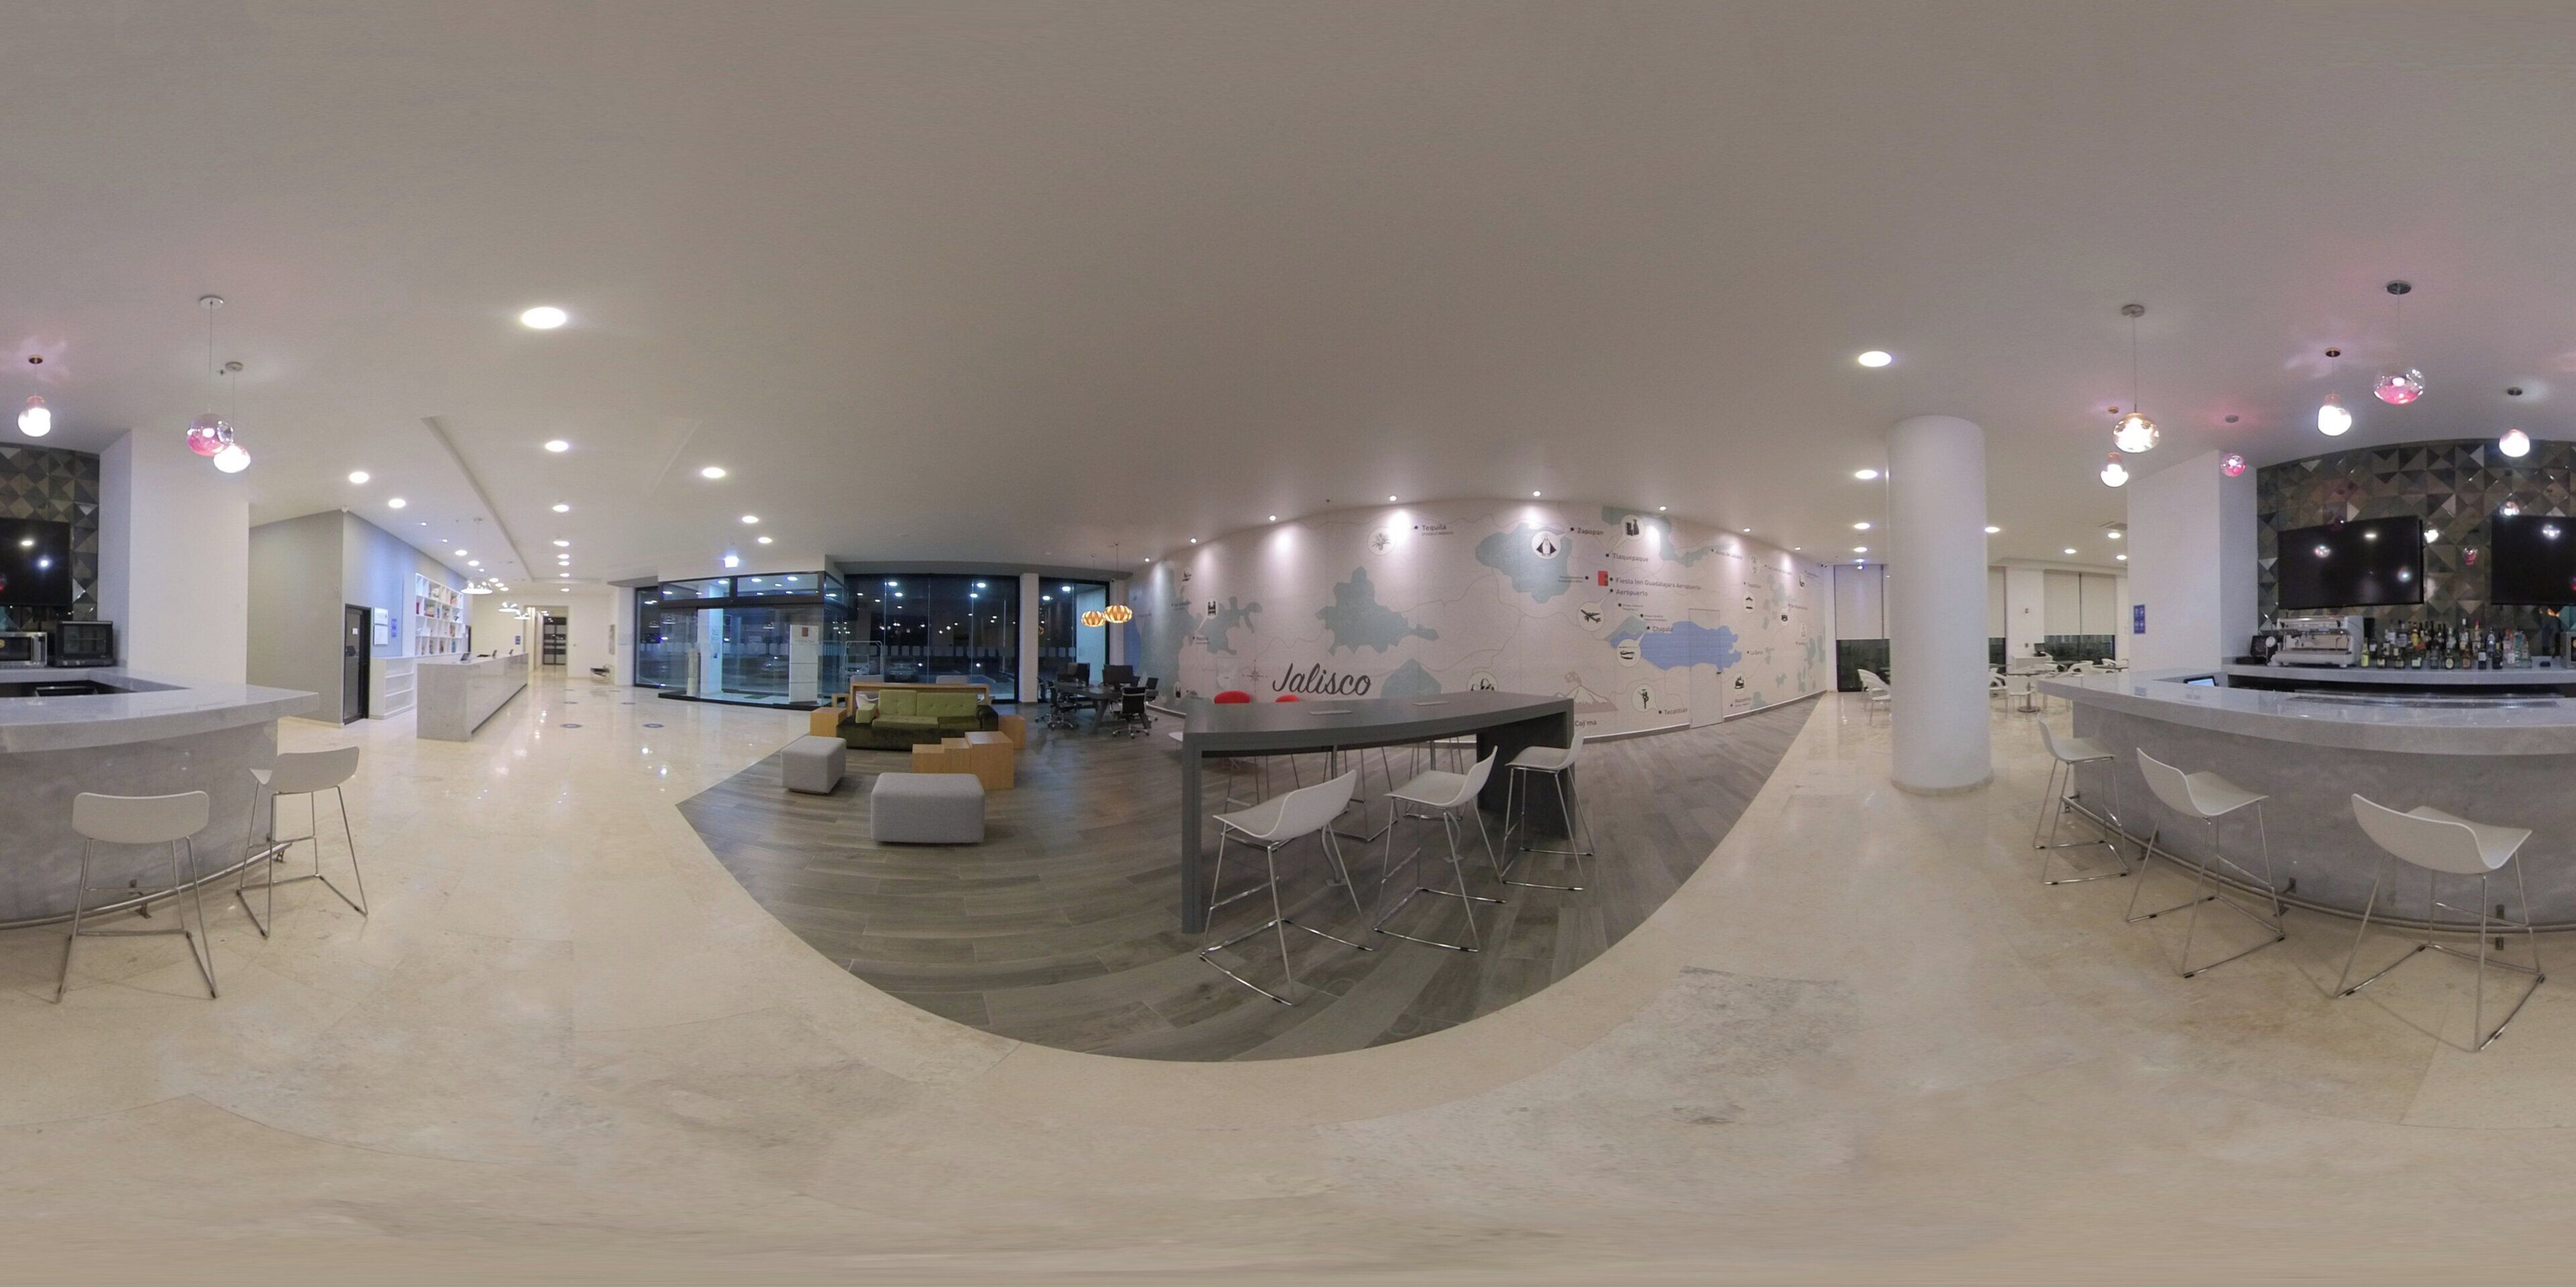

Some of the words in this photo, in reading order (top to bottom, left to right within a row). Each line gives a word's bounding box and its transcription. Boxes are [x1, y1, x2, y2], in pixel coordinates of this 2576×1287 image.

[1577, 527, 1604, 536] Zapopan
[1612, 553, 1649, 562] Tlaquepaque
[1616, 577, 1634, 585] Fiesta
[1645, 579, 1676, 588] Guadalajara
[1273, 663, 1371, 696] Jalisco
